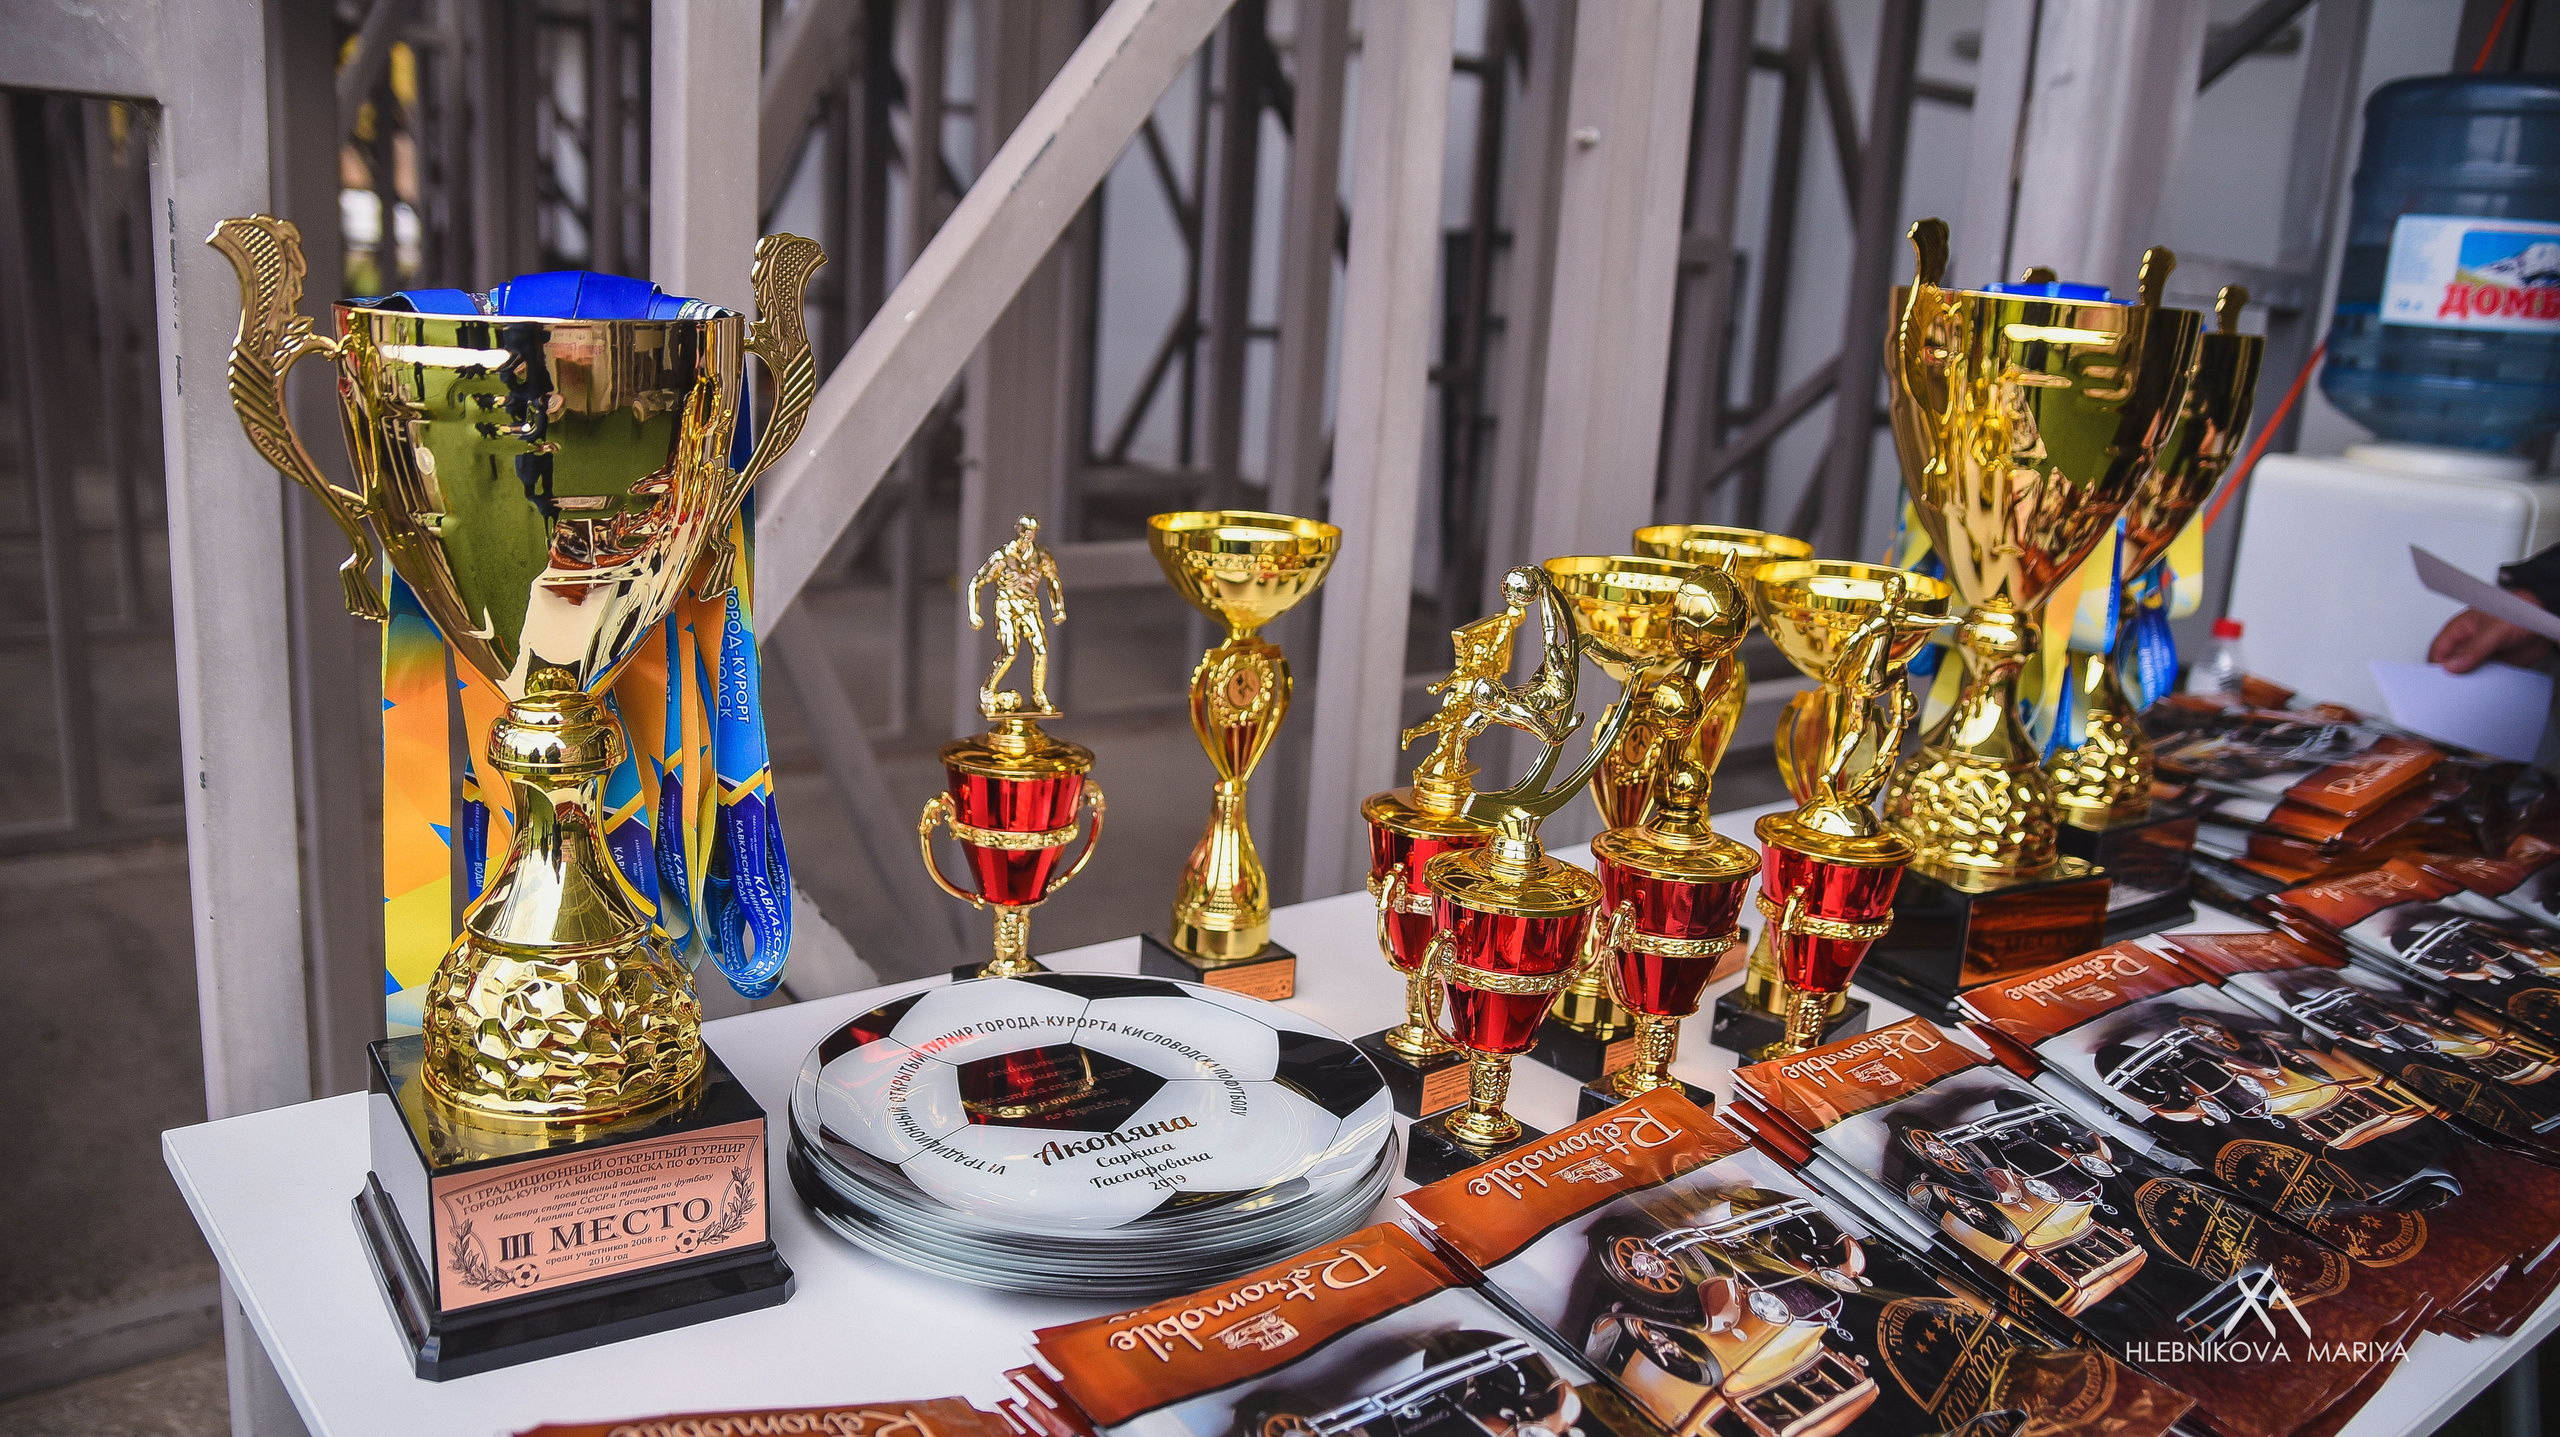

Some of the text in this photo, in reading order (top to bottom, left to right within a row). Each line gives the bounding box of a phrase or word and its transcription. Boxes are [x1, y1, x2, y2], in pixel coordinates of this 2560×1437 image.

[474, 861, 484, 887] ВОДЫ
[736, 820, 752, 887] КАВКАЗСКИЕ
[747, 888, 772, 957] МИНЕРАЛЬНЫЕ
[736, 875, 750, 905] ВОДЫ
[753, 876, 783, 977] КАВКАЗСКИЕ
[2004, 949, 2149, 1008] Retromobile
[921, 1026, 974, 1055] ТУРНИР
[975, 1015, 1117, 1034] ГОРОДА-КУРОРТА
[1121, 1025, 1221, 1070] КИСЛОВОДСКА
[889, 1050, 929, 1103] ОТКРЫТЫЙ
[1781, 1025, 1942, 1089] Retromobile
[1223, 1079, 1249, 1117] ФУТБОЛУ
[888, 1106, 987, 1171] ТРАДИЦИОННЫЙ
[1032, 1115, 1198, 1167] Акопяна
[1096, 1142, 1176, 1168] Саркиса
[1468, 1107, 1683, 1200] Retromobile
[455, 1143, 746, 1206] VI ТРАДИЦИОННЫЙ ОТКРЫТЫЙ ТУРНИР
[463, 1154, 741, 1216] ГОРОДА-КУРОРТА КИСЛОВОДСКА ПО ФУТБОЛУ
[493, 1206, 538, 1222] Мастера
[541, 1200, 577, 1214] спорта
[580, 1193, 610, 1205] СССР
[619, 1185, 659, 1198] тренера
[661, 1182, 672, 1190] по
[673, 1173, 714, 1188] футболу
[553, 1175, 657, 1201] посвященный памяти
[1148, 1174, 1187, 1191] 2019
[498, 1197, 714, 1263] III МЕСТО
[533, 1190, 677, 1224] Акопяна Саркиса Гаспаровича
[545, 1253, 573, 1265] среди
[576, 1241, 629, 1261] участников
[631, 1236, 653, 1248] 2008
[588, 1252, 629, 1266] 2019 год
[1109, 1248, 1388, 1363] Retromobile
